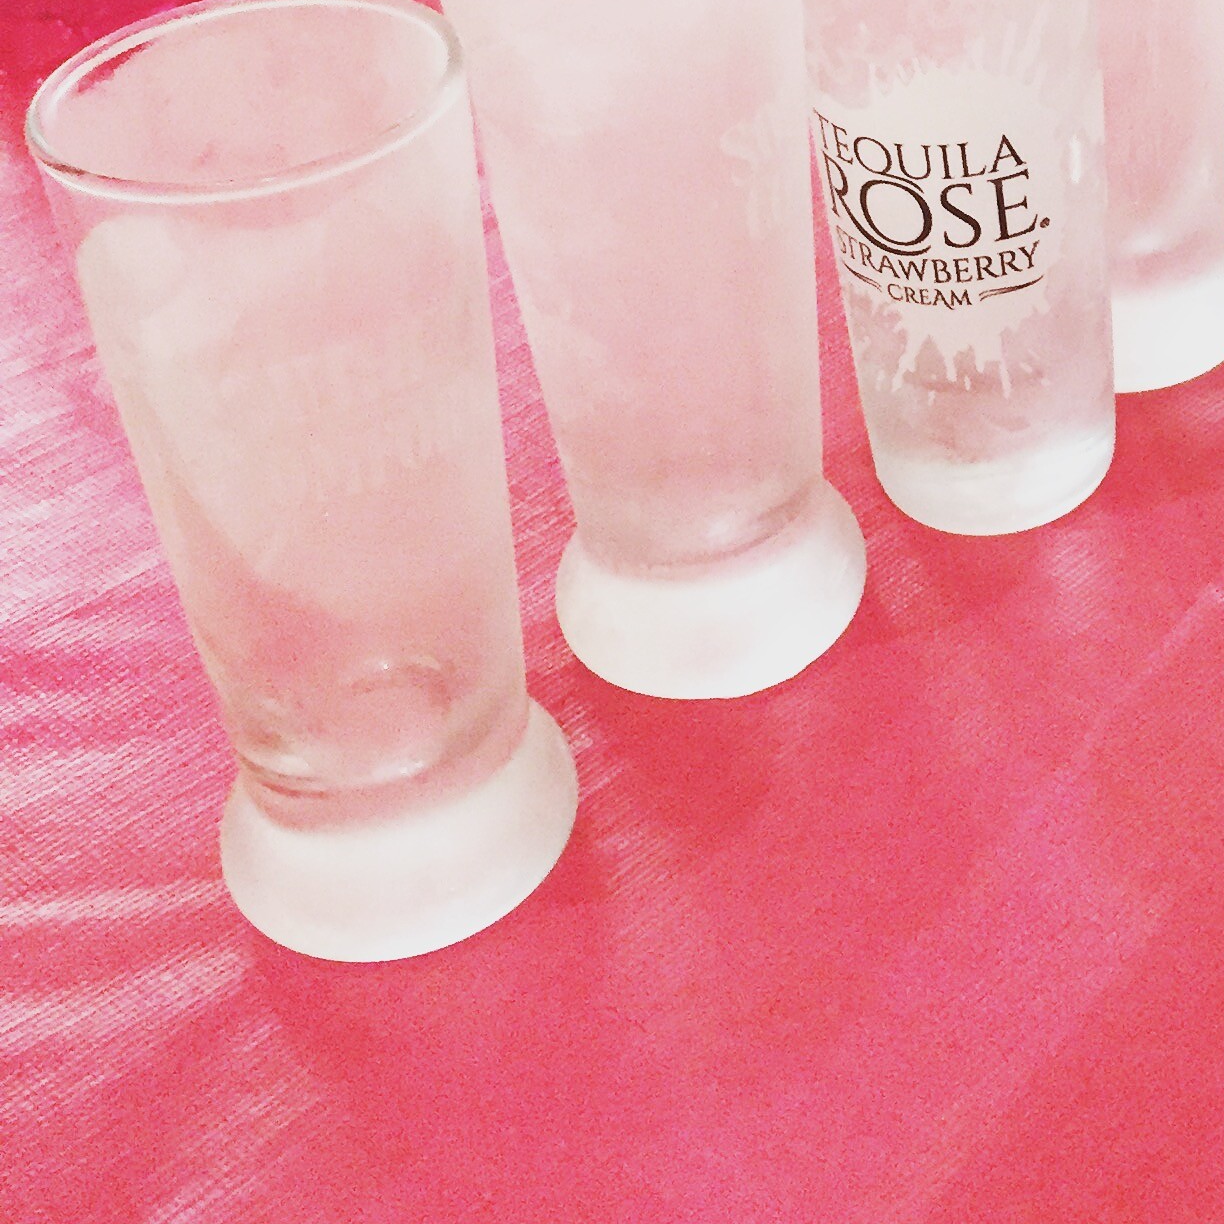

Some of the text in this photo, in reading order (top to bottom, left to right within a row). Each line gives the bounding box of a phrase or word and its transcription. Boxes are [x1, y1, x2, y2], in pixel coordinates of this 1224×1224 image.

[812, 107, 1028, 193] TEQUILA
[836, 225, 1041, 285] STRAWBERRY
[886, 283, 973, 311] CREAM
